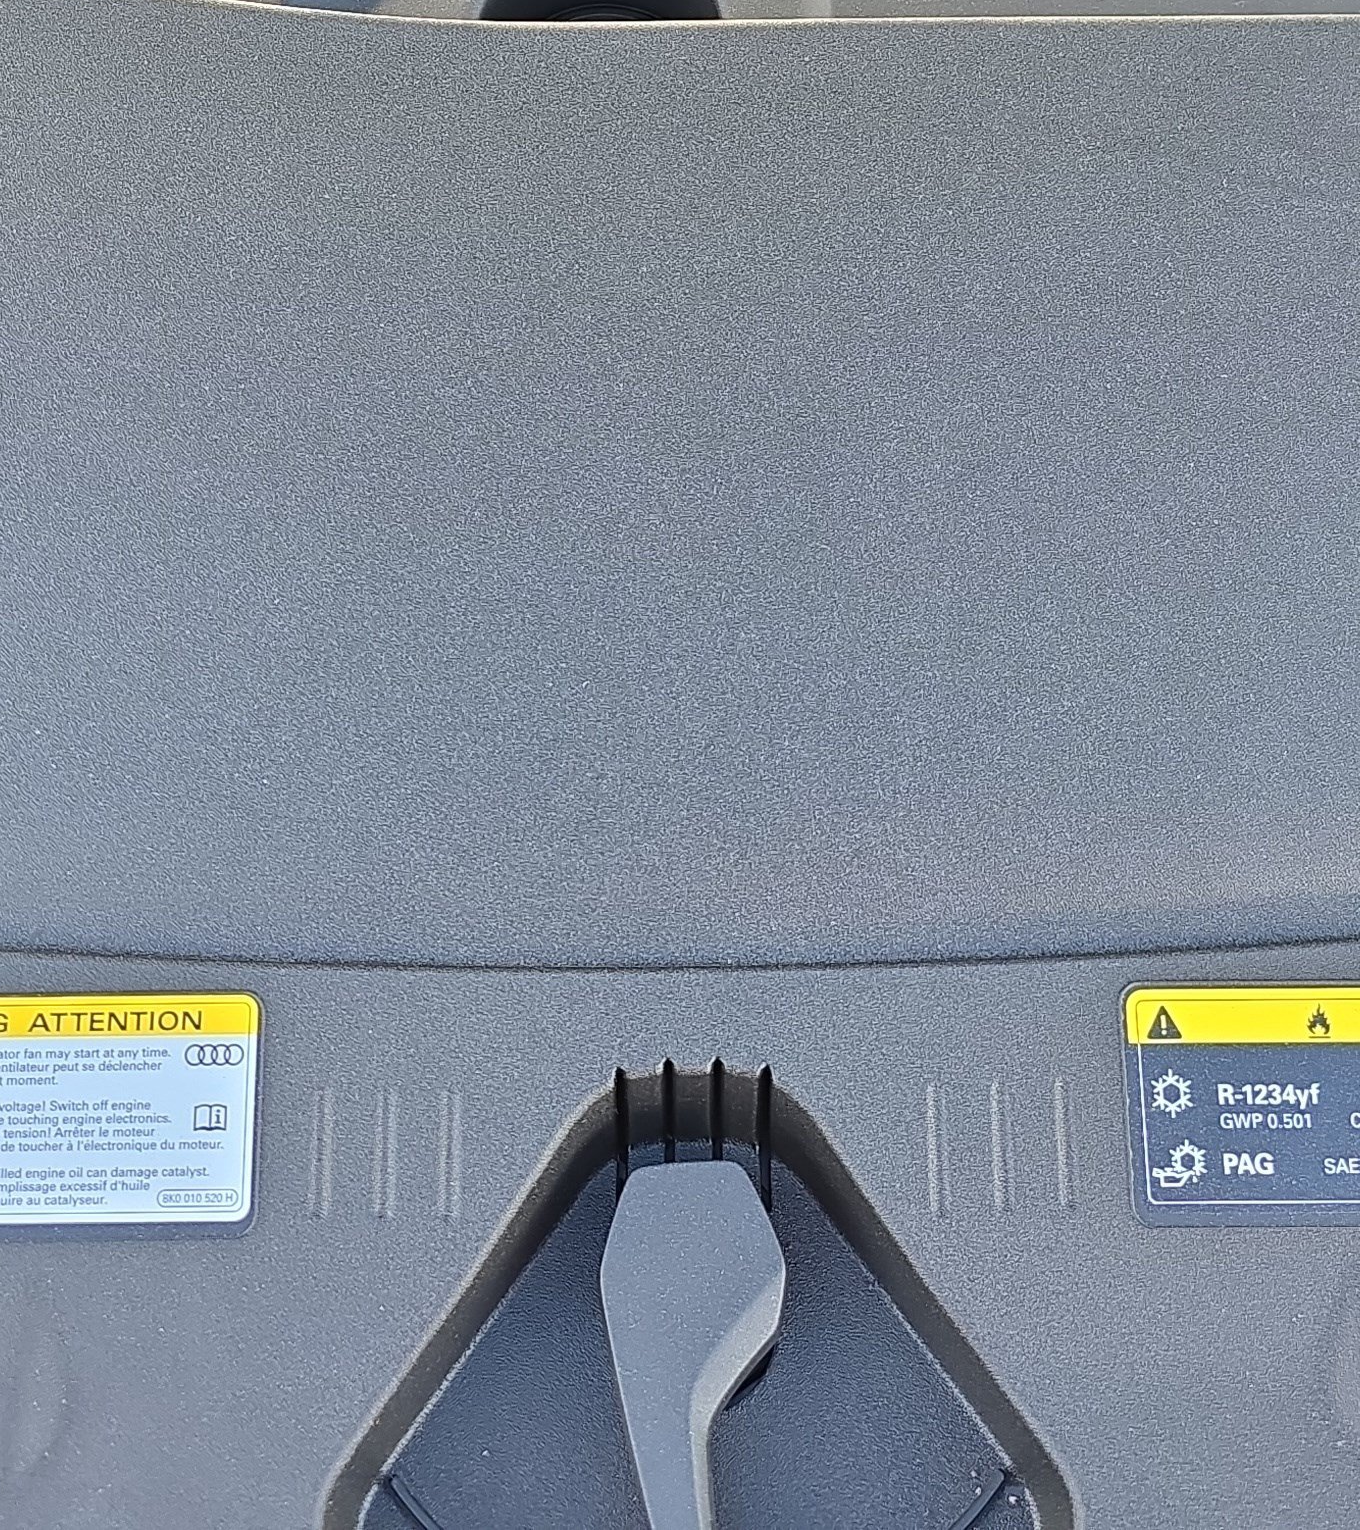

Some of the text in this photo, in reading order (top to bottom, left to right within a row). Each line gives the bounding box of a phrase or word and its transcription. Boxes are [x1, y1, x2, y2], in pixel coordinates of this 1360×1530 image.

[27, 1010, 202, 1033] ATTENTION
[23, 1047, 42, 1060] fan
[45, 1050, 72, 1062] may
[73, 1048, 101, 1059] start
[102, 1048, 115, 1062] at
[117, 1049, 140, 1062] any
[141, 1046, 172, 1062] time.
[52, 1061, 80, 1074] peut
[81, 1063, 96, 1072] se
[97, 1059, 163, 1072] déclencher
[6, 1075, 59, 1086] moment.
[1216, 1082, 1322, 1110] R-1234yf
[49, 1099, 90, 1115] Switch
[92, 1099, 110, 1111] off
[110, 1100, 151, 1113] engine
[7, 1112, 59, 1128] touching
[62, 1112, 103, 1127] engine
[105, 1112, 172, 1125] electronics.
[1219, 1113, 1313, 1129] GWP 0.501
[2, 1126, 52, 1139] tension!
[53, 1126, 96, 1138] Arrêter
[98, 1126, 110, 1138] le
[112, 1127, 156, 1138] moteur
[0, 1140, 16, 1153] de
[18, 1140, 64, 1152] toucher
[66, 1139, 74, 1152] à
[76, 1138, 158, 1153] l'électronique
[159, 1138, 176, 1151] du
[178, 1139, 225, 1150] moteur.
[1222, 1153, 1275, 1176] PAG
[1323, 1158, 1360, 1175] SAE
[25, 1166, 66, 1181] engine
[68, 1166, 84, 1179] oil
[86, 1169, 108, 1178] can
[110, 1166, 159, 1180] damage
[161, 1165, 210, 1179] catalyst.
[59, 1179, 108, 1192] excessif
[109, 1179, 151, 1192] d'huile
[25, 1196, 41, 1206] au
[43, 1193, 108, 1208] catalyseur.
[161, 1192, 234, 1204] 8K0 010 520 H
